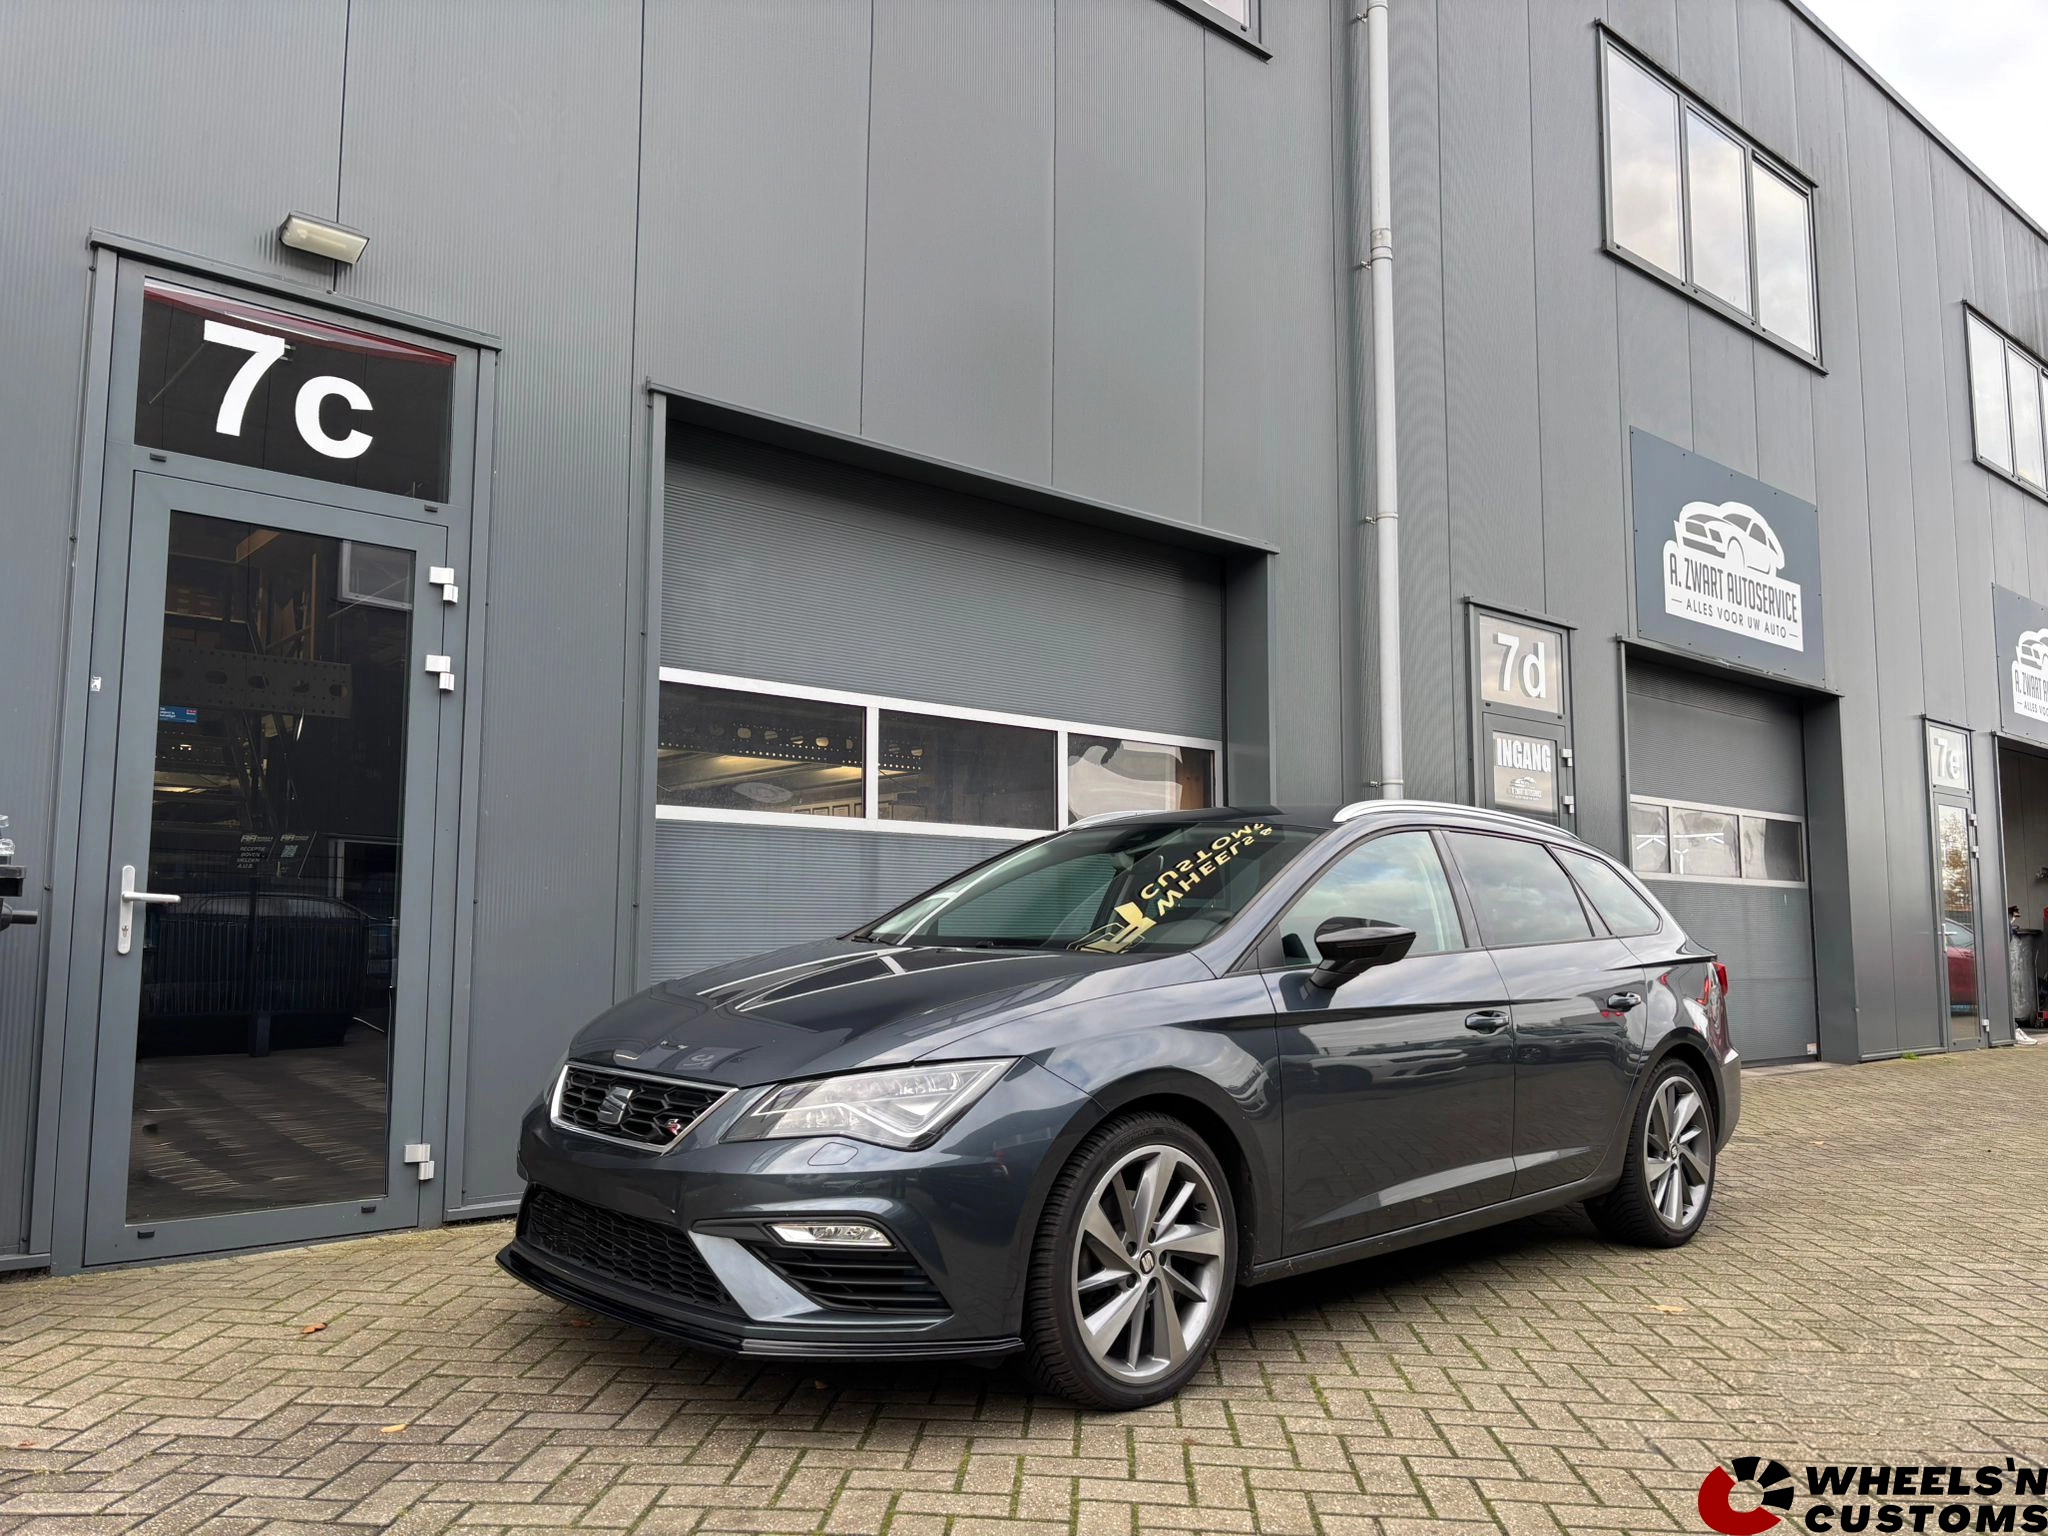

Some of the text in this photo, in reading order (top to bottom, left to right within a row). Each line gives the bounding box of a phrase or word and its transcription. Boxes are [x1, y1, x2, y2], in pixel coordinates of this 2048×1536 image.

[203, 319, 373, 459] 7c
[1669, 553, 1798, 623] A. ZWART AUTOSERVICE
[1686, 598, 1787, 639] ALLES VOOR UW AUTO
[1497, 631, 1546, 699] 7d
[2022, 672, 2042, 700] ZWART
[1496, 738, 1551, 772] INGANG
